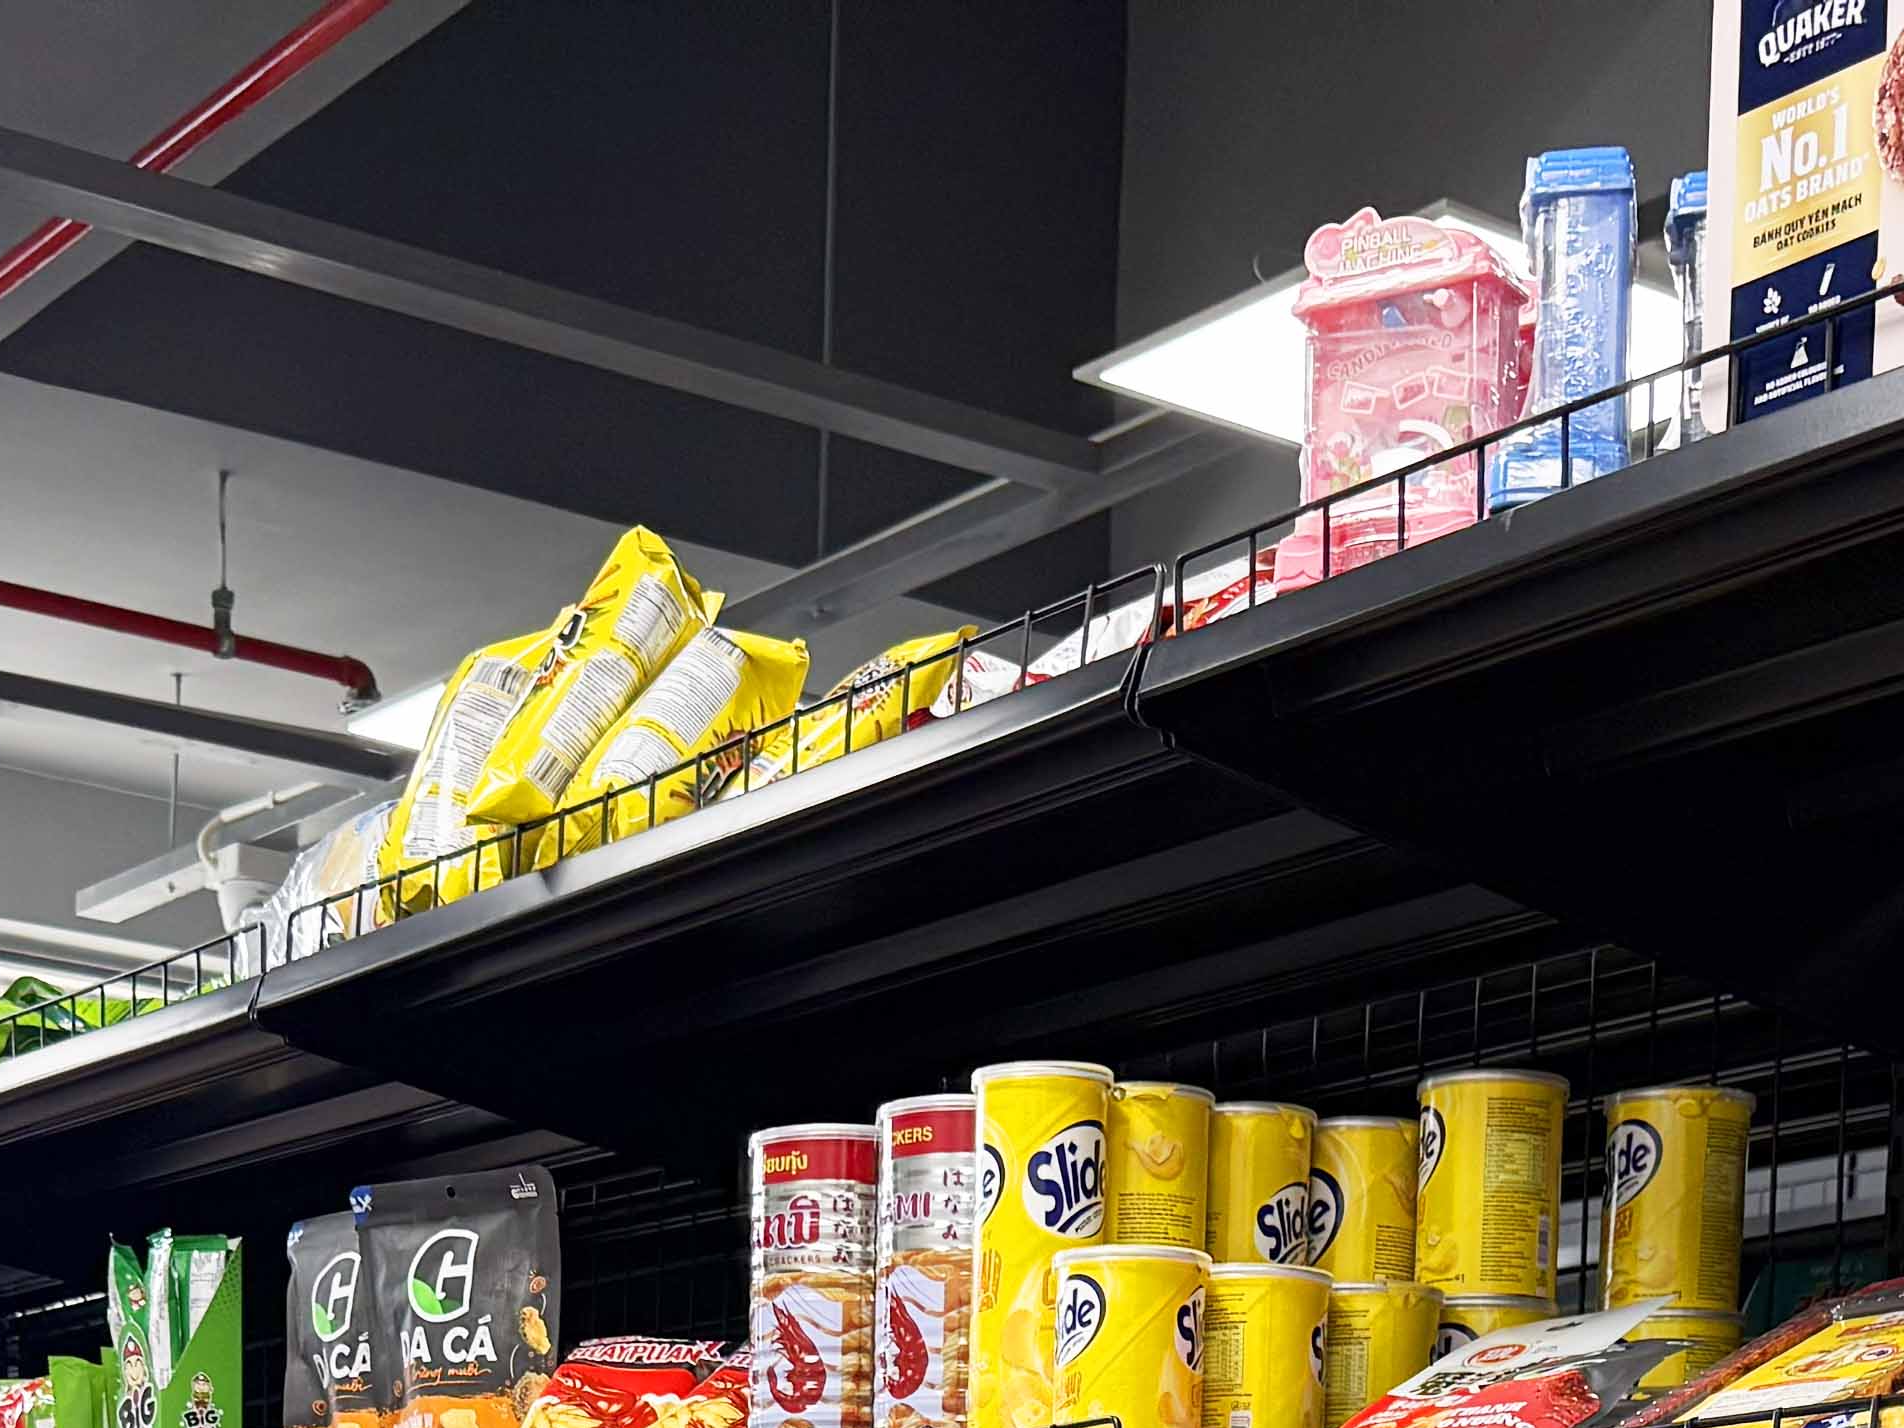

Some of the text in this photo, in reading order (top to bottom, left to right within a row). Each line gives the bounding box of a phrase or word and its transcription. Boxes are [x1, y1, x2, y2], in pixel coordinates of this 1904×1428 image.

[1758, 0, 1865, 66] QUAKER
[1772, 85, 1840, 130] WORLD'S
[1760, 104, 1849, 192] No.1
[1744, 186, 1792, 222] OATS
[1777, 220, 1836, 251] OAT COOKIES
[442, 1314, 497, 1365] CÁ
